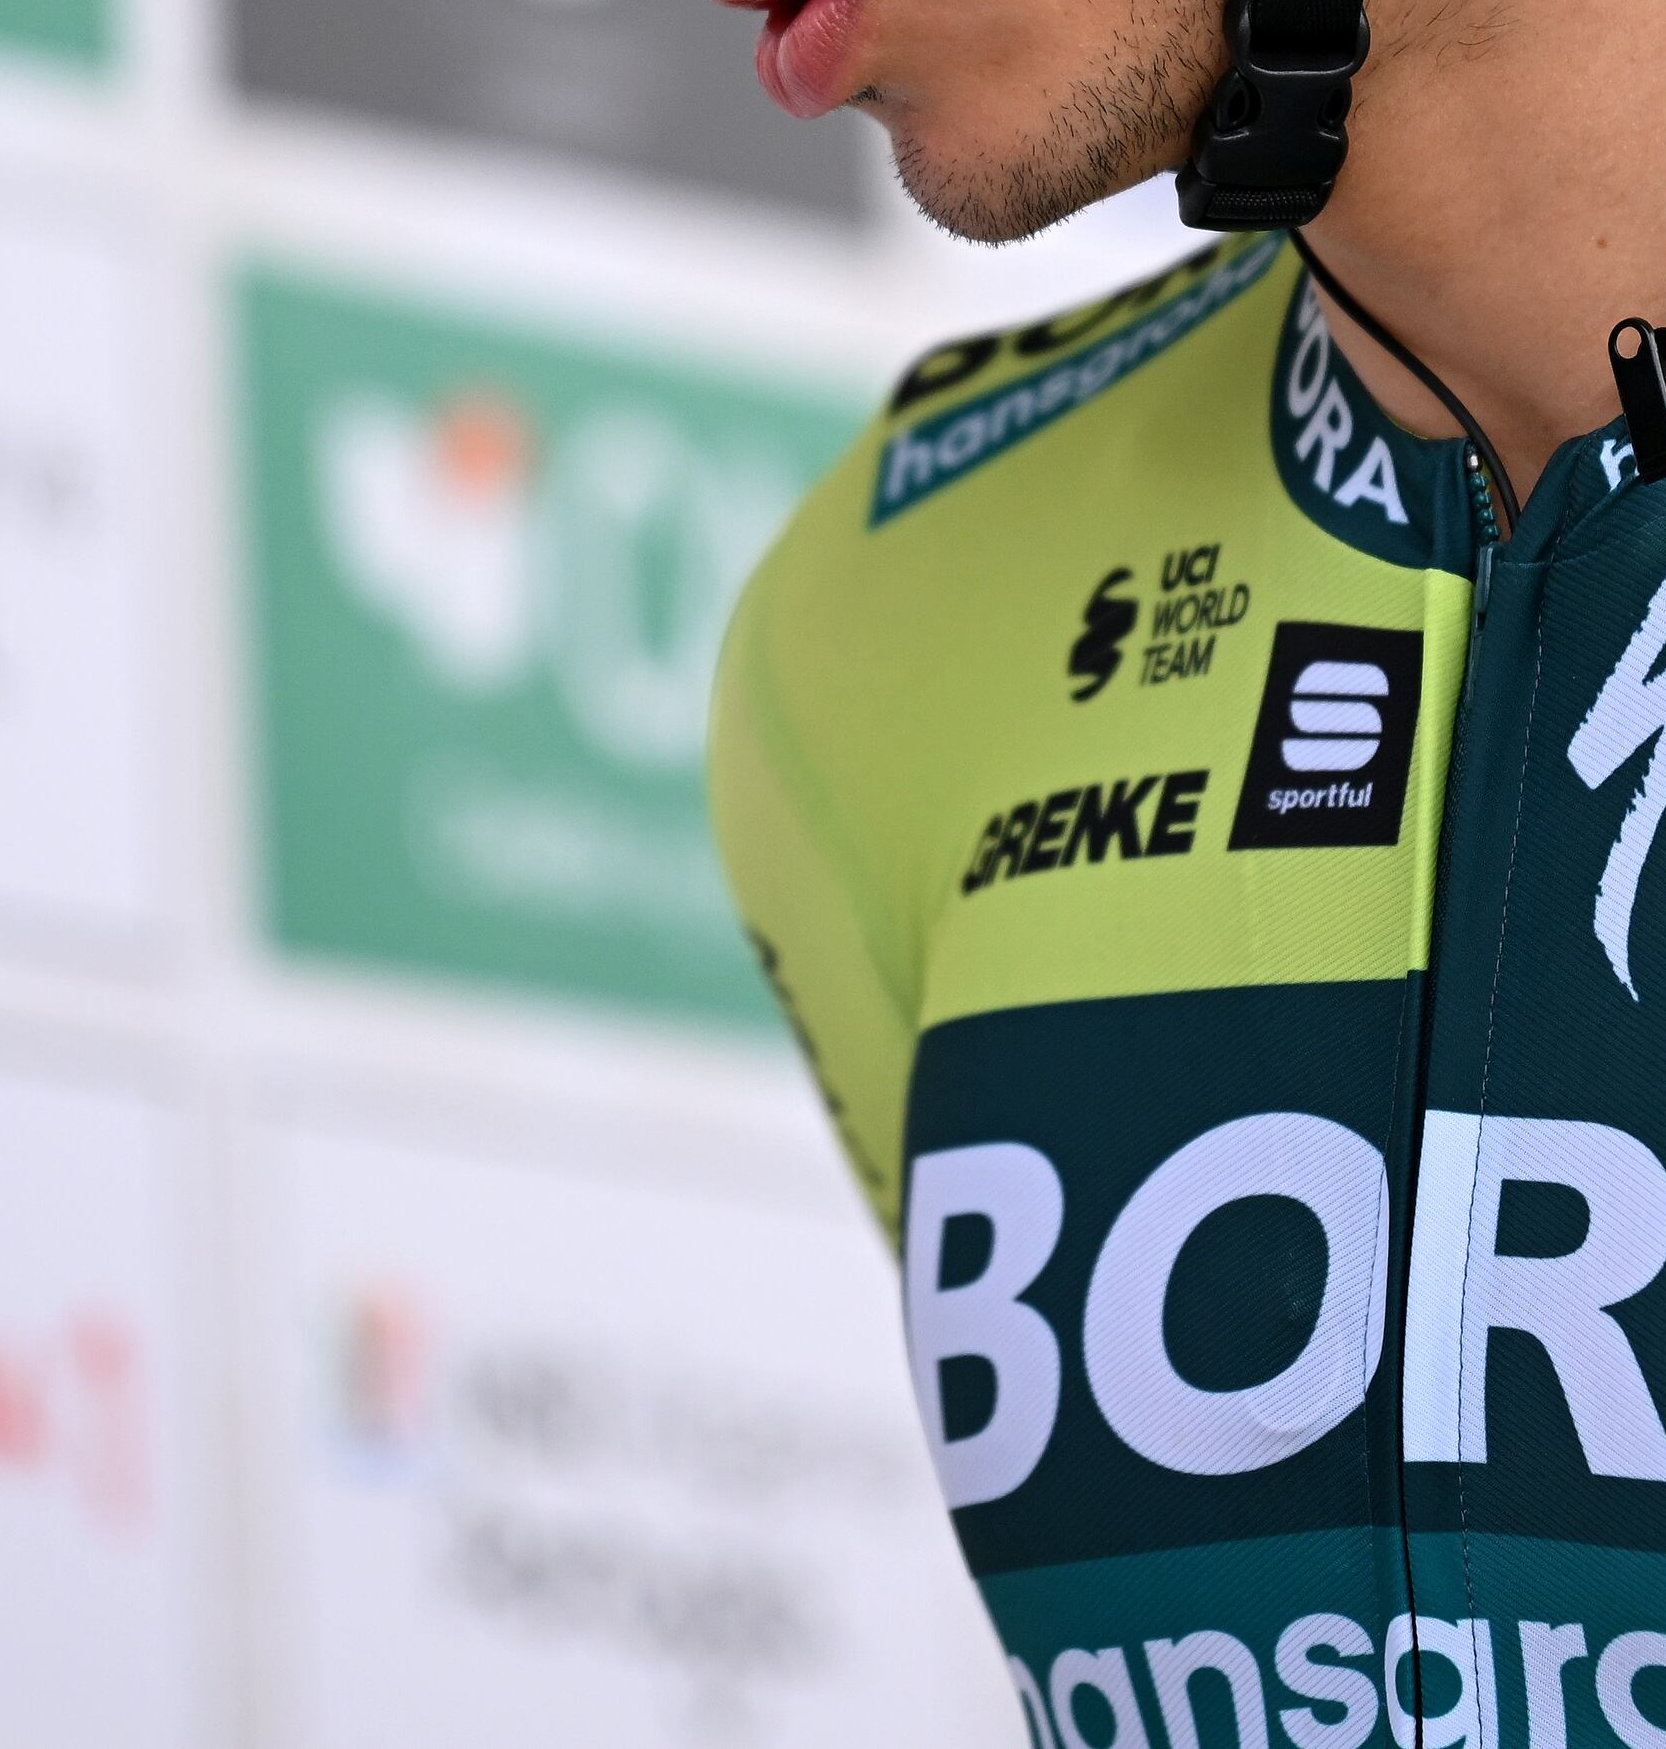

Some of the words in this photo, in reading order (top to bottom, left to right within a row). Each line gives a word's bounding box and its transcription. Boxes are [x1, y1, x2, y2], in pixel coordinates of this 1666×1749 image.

[1161, 543, 1221, 593] UCI
[1151, 583, 1250, 640] WORLD
[1139, 635, 1217, 687] TEAM
[1266, 782, 1374, 814] sportful
